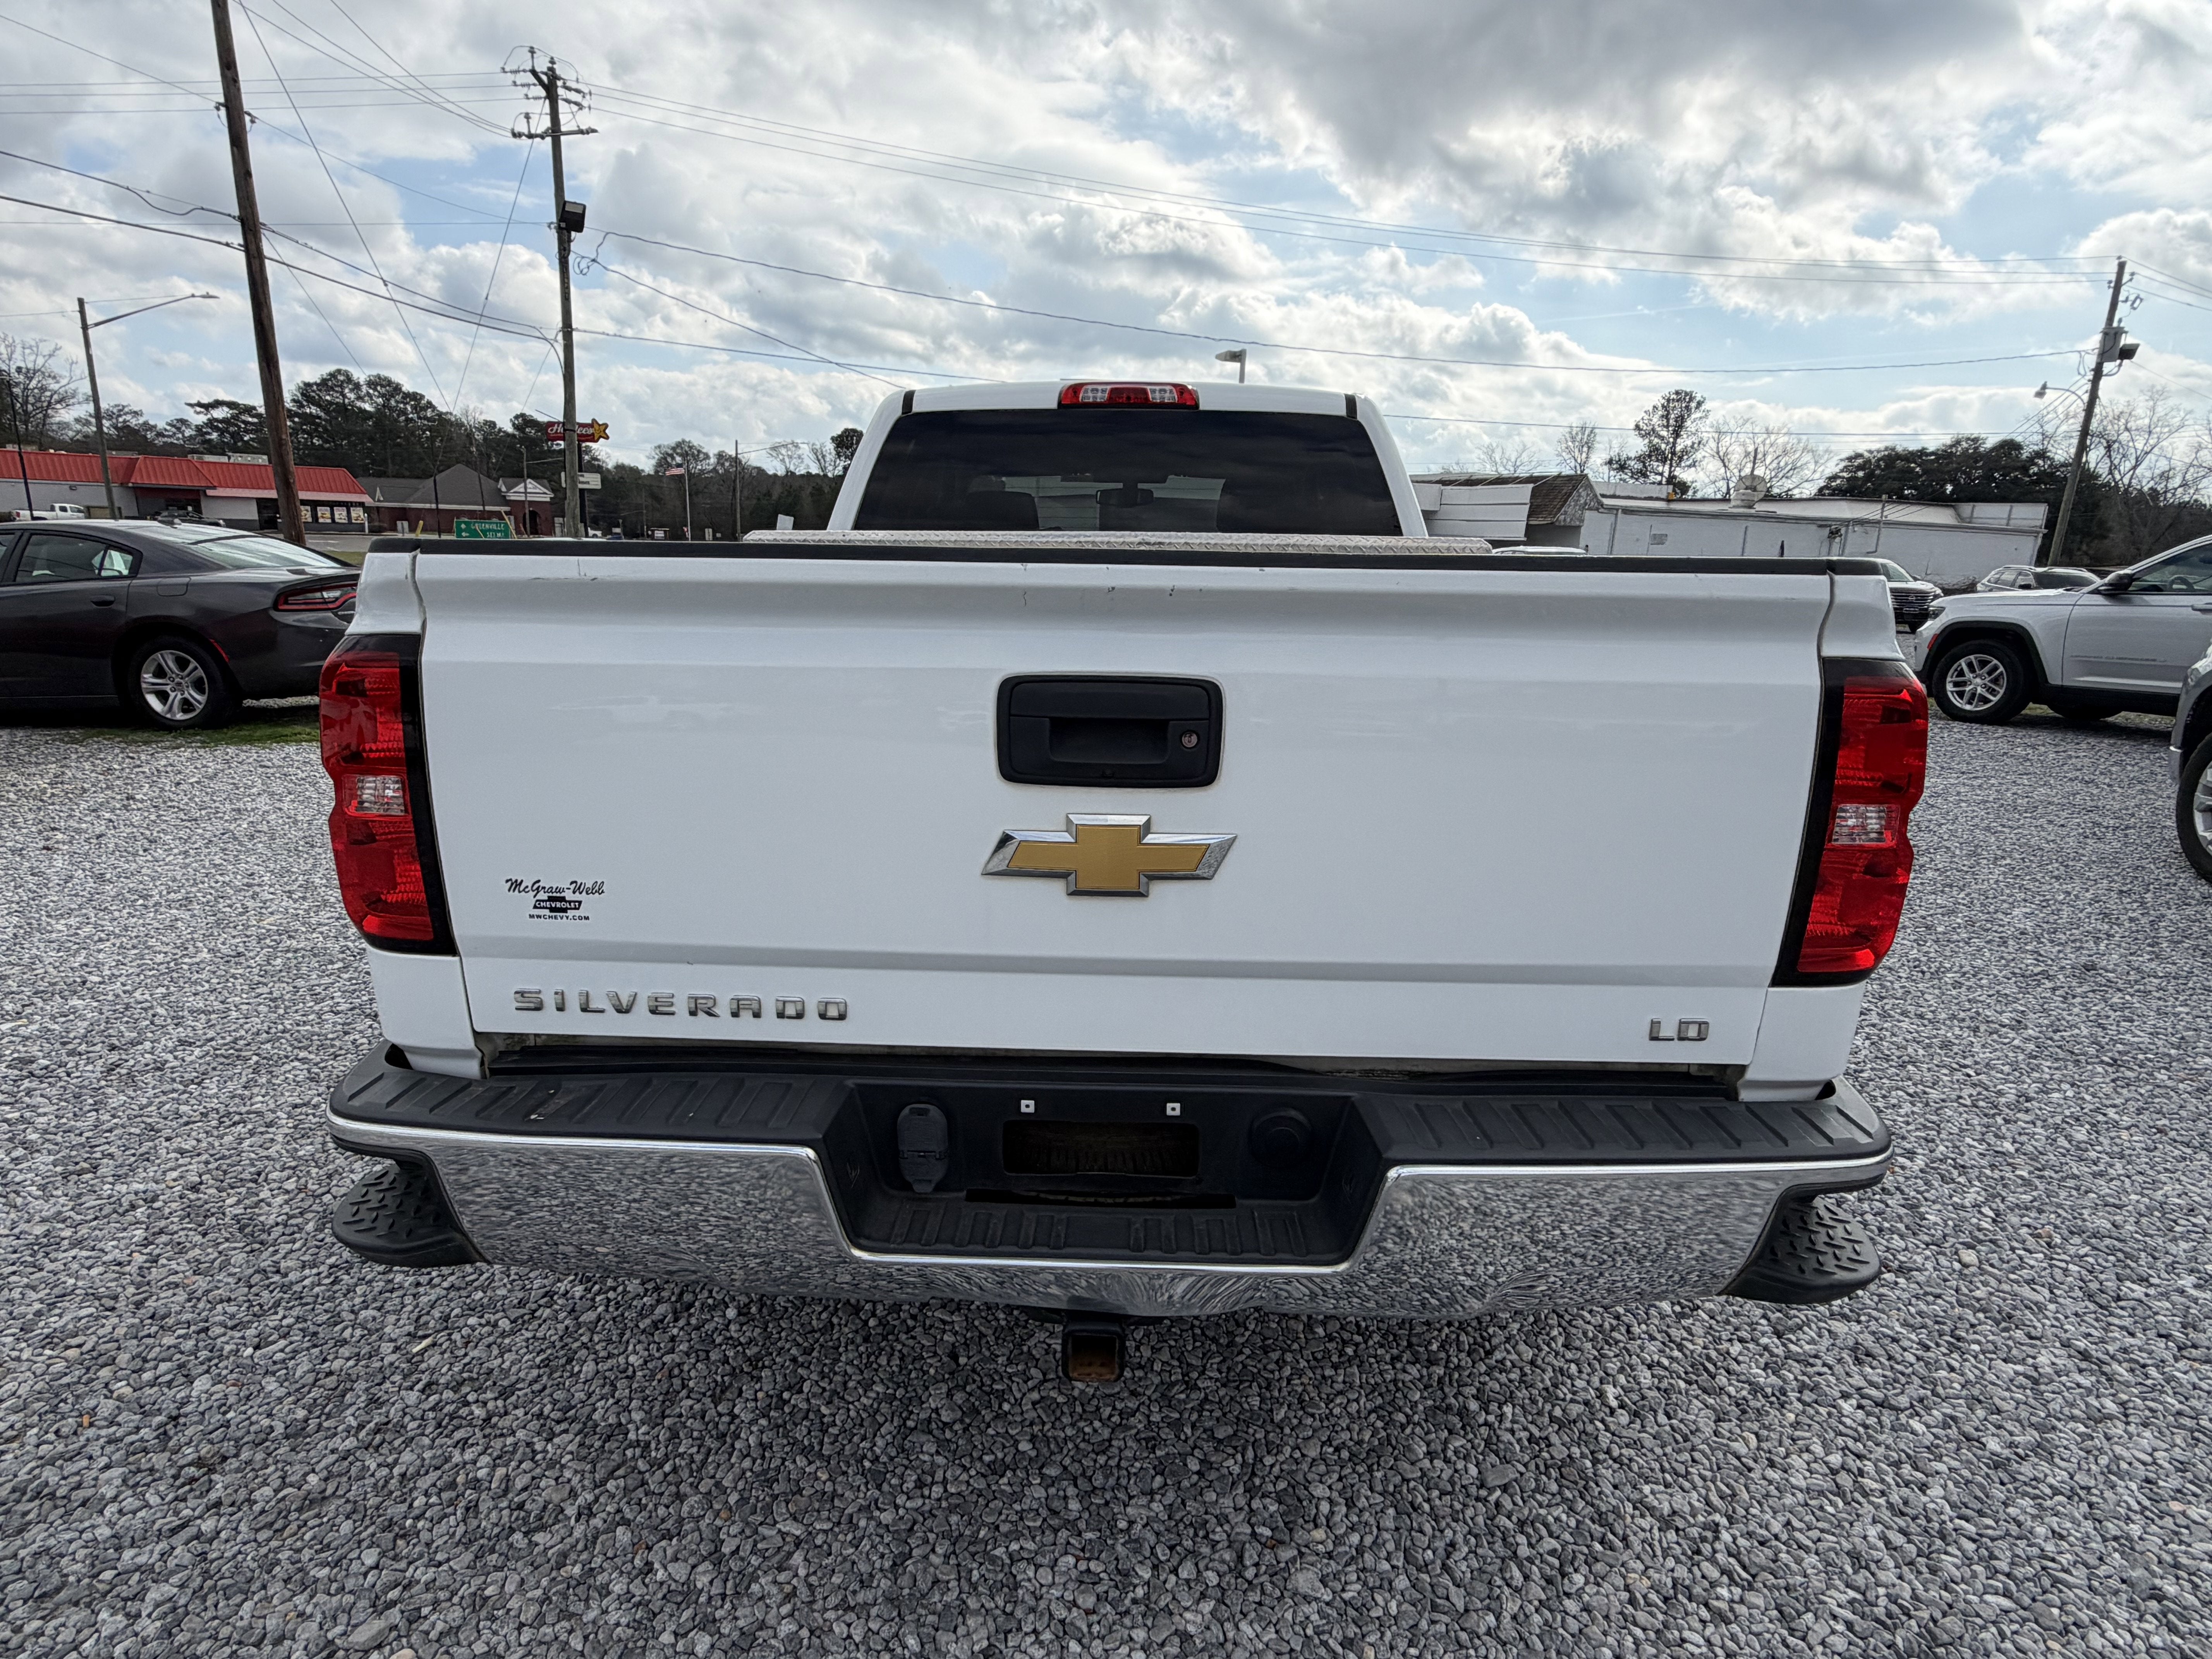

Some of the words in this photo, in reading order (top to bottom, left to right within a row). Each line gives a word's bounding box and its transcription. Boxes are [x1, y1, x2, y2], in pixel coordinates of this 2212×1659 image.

[505, 878, 605, 898] McGraw-Webb
[514, 988, 847, 1021] SILVERADO
[1649, 1018, 1709, 1041] LD
